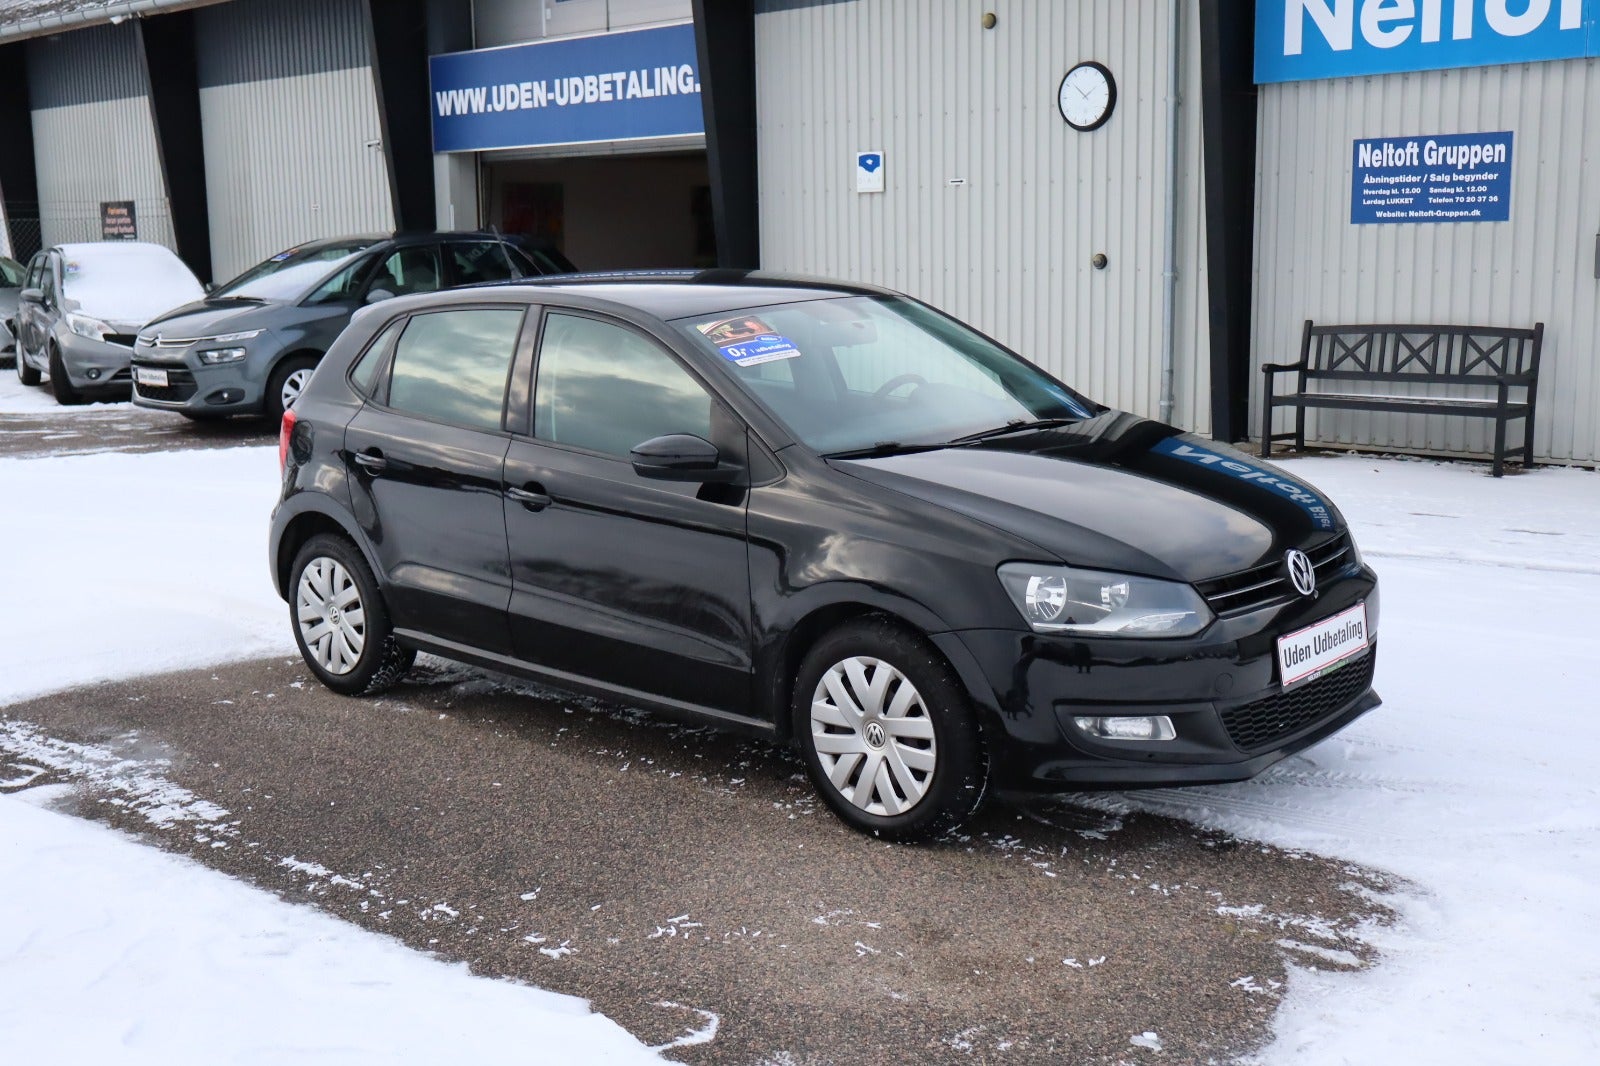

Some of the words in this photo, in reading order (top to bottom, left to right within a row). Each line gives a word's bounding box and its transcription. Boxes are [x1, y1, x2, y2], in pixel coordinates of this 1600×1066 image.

[1358, 142, 1419, 167] Neltoft
[1424, 140, 1506, 169] Gruppen
[1363, 174, 1421, 185] Åbningstider
[1429, 173, 1451, 183] Salg
[1452, 172, 1499, 182] begynder
[1363, 188, 1391, 196] Hverdag
[1391, 187, 1399, 195] kl.
[1376, 210, 1408, 218] Website:
[1408, 209, 1481, 218] Neltoft-Gruppen.dk
[1284, 643, 1311, 668] Uden
[1313, 620, 1363, 656] Udbetaling
